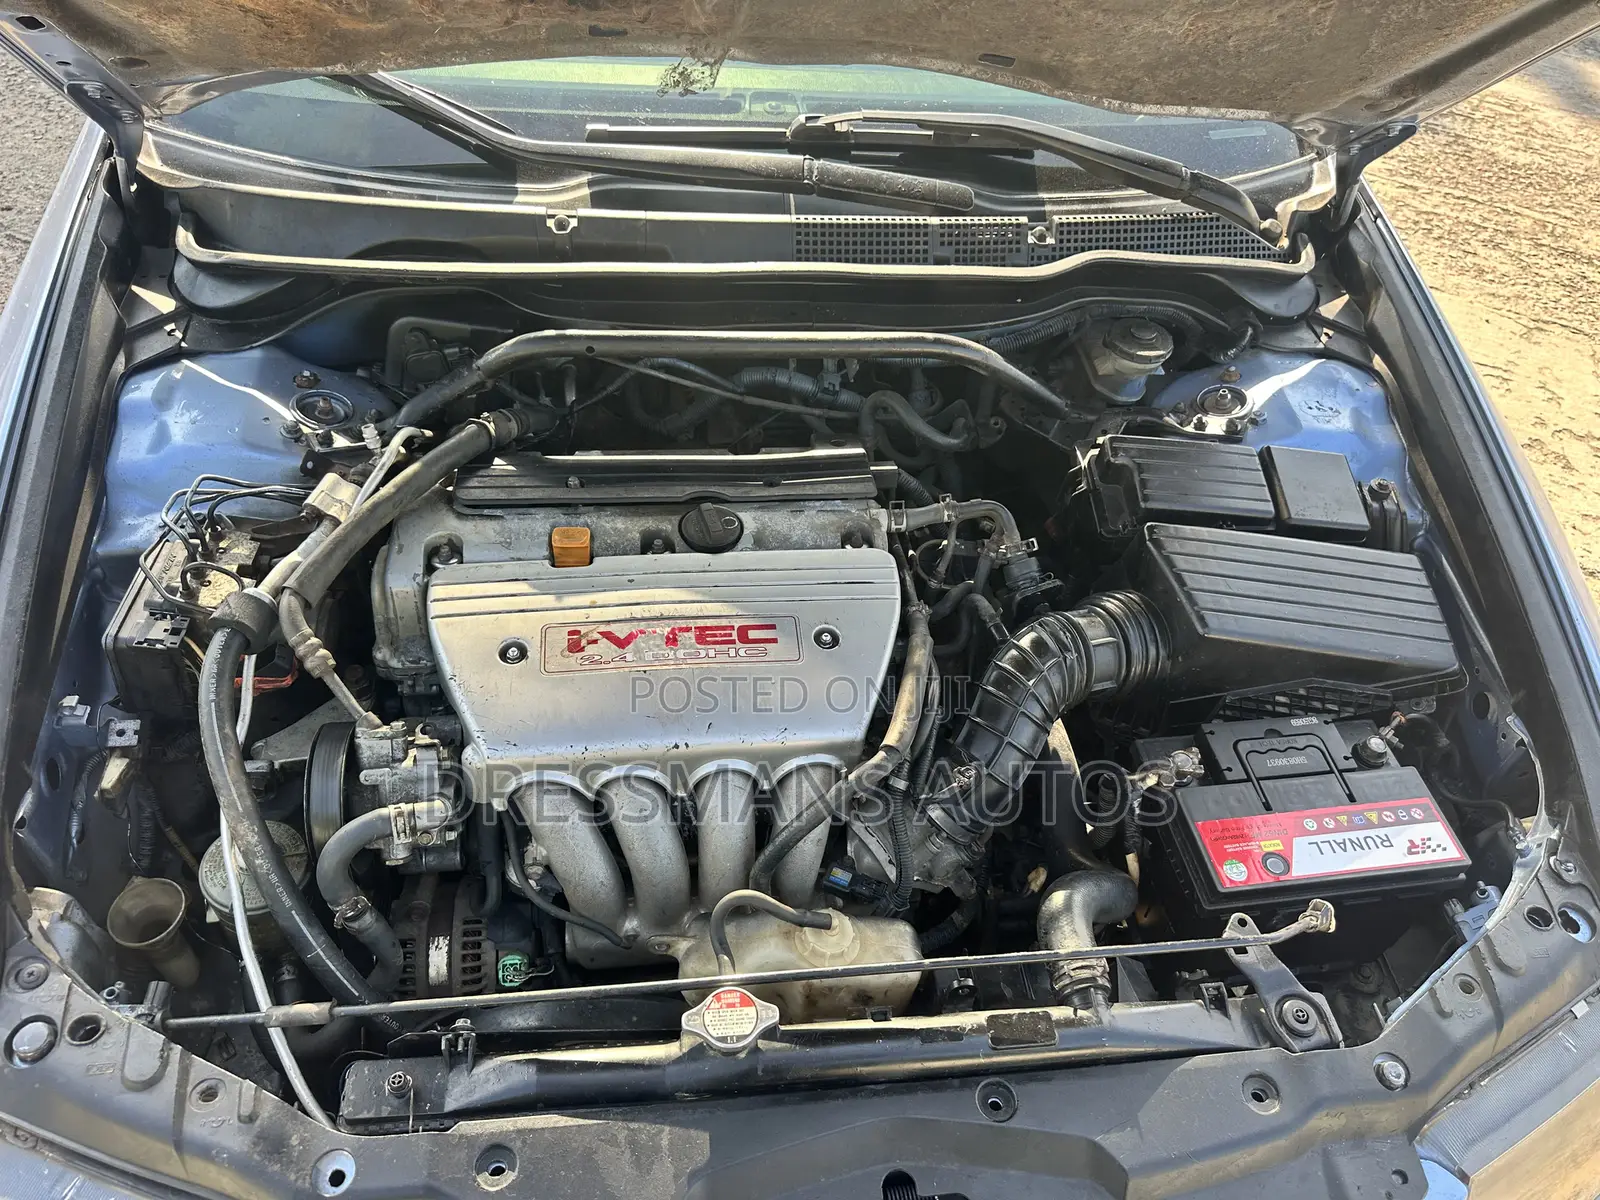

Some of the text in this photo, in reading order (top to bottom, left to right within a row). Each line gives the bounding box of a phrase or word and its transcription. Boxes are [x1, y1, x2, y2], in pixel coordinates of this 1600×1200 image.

[578, 647, 768, 666] 2.4 DOHC
[1307, 833, 1394, 856] RUNALL
